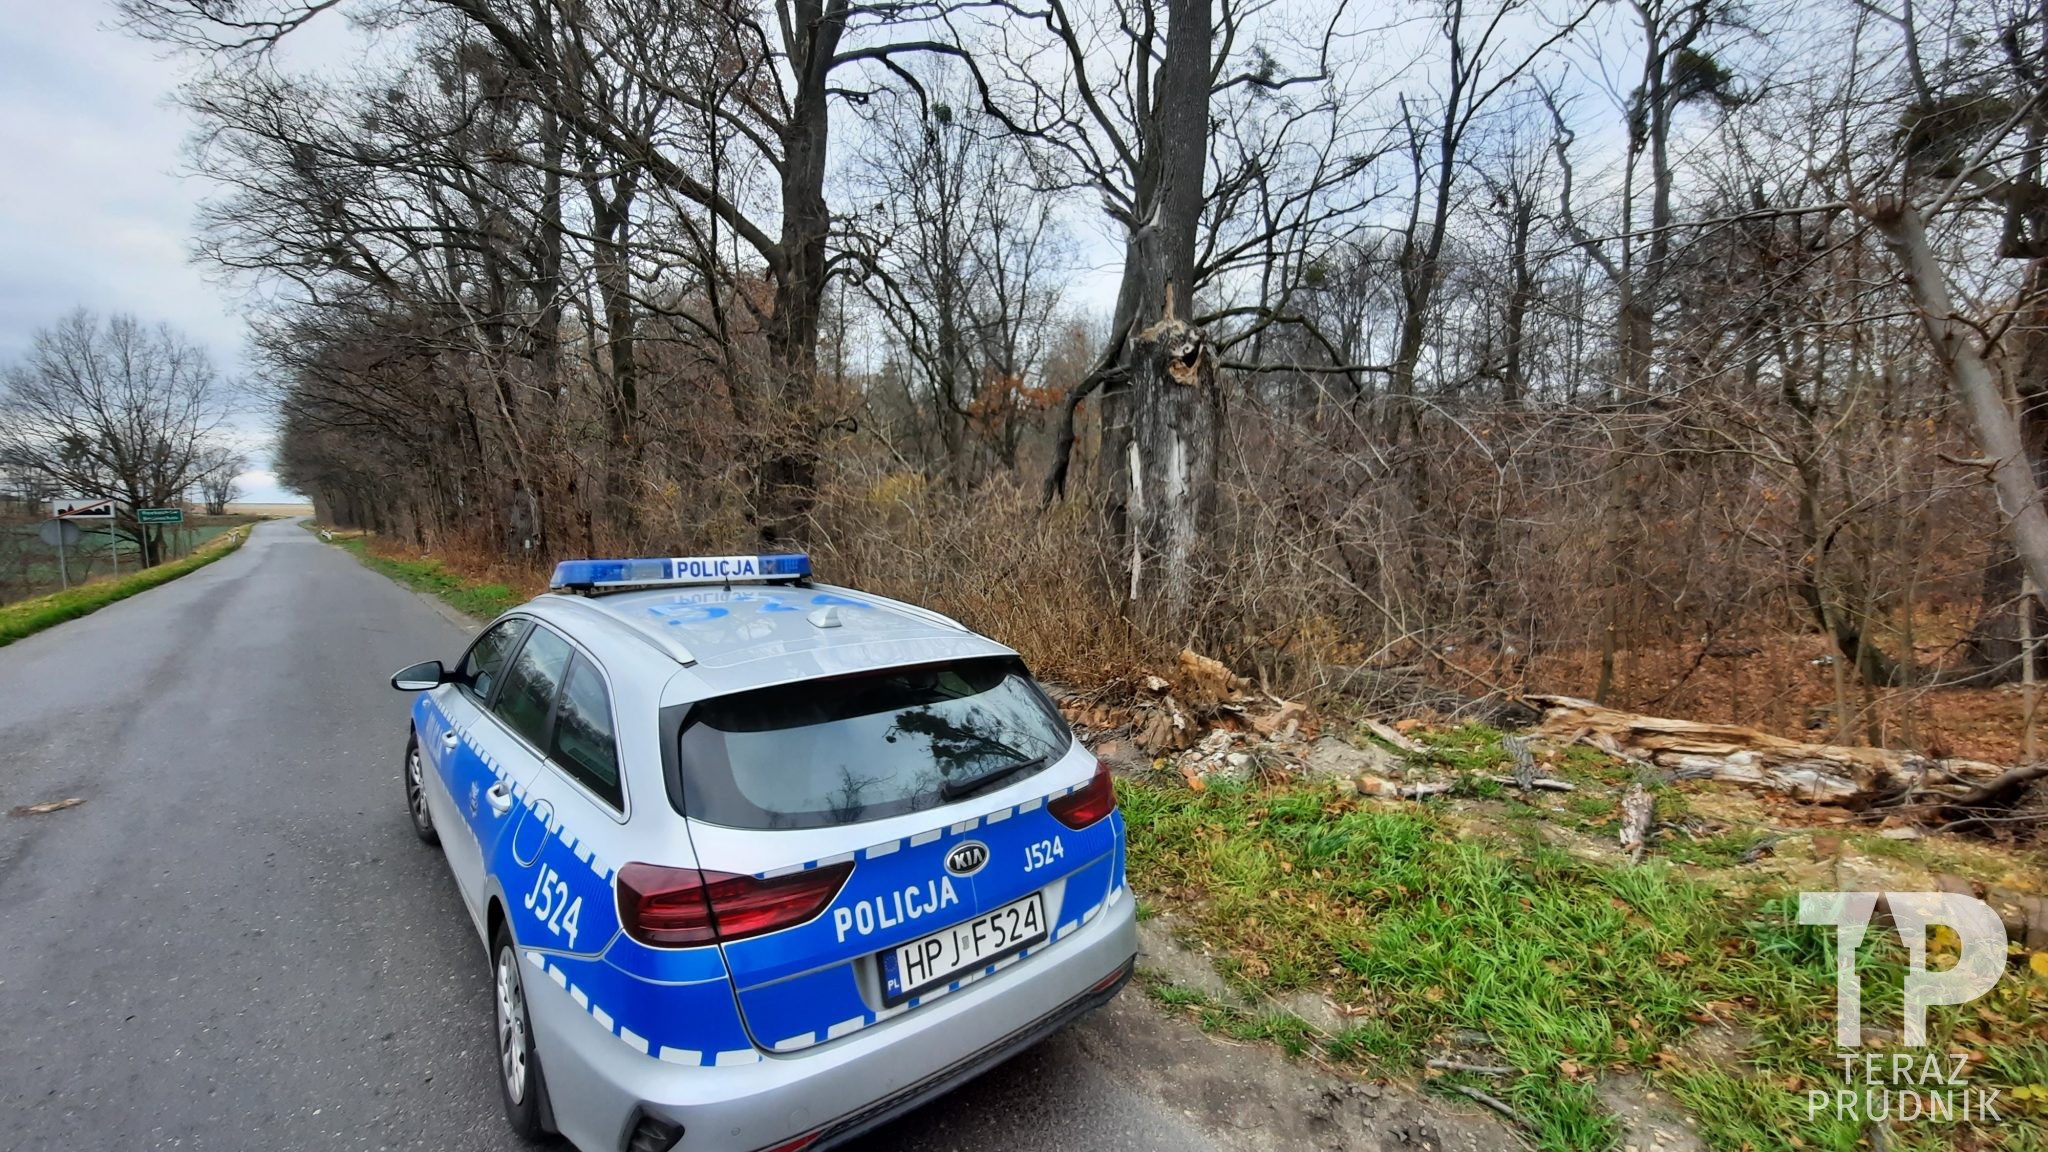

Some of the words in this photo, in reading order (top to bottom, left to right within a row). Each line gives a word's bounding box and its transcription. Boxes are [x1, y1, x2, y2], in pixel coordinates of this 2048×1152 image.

[676, 559, 755, 579] POLICJA
[954, 848, 984, 870] KIA
[1023, 835, 1064, 873] J524
[524, 863, 583, 949] J524
[834, 875, 959, 943] POLICJA
[887, 979, 900, 990] PL
